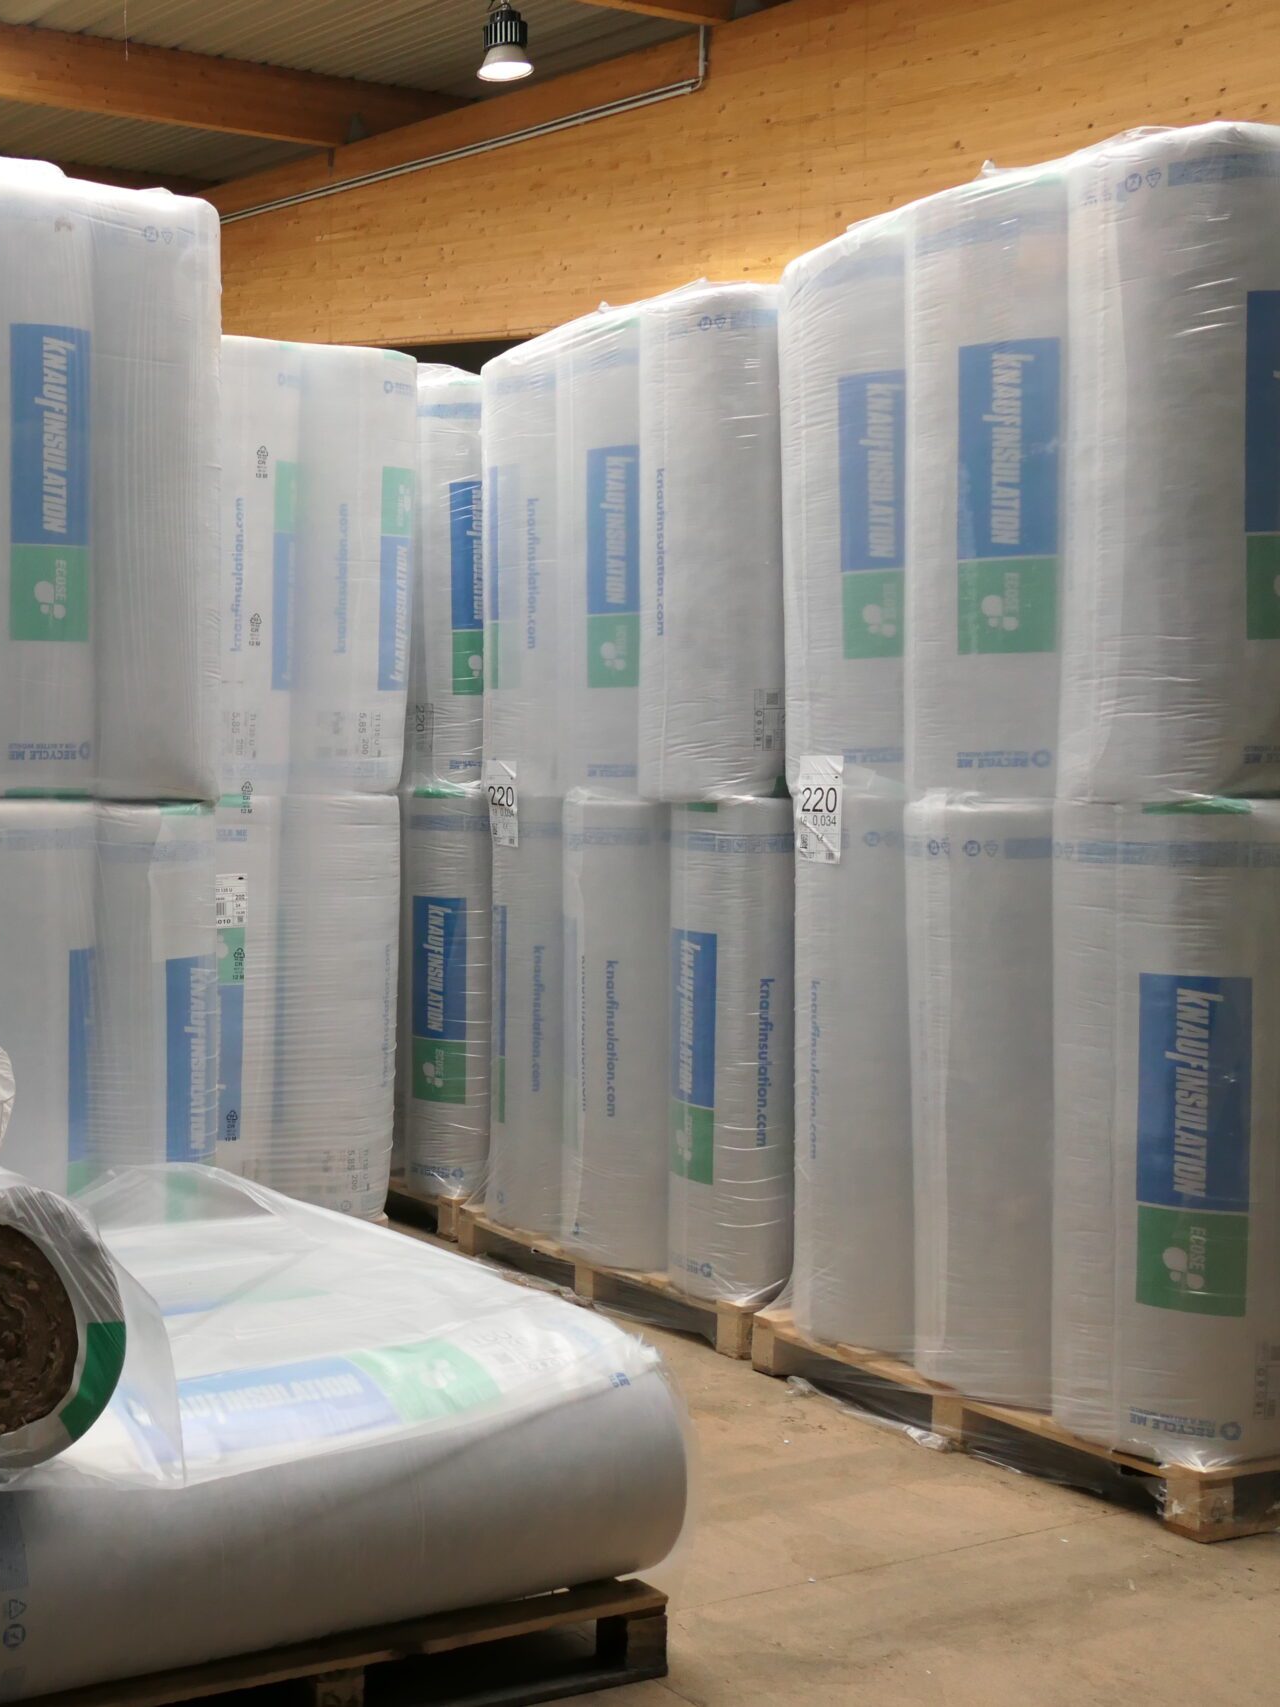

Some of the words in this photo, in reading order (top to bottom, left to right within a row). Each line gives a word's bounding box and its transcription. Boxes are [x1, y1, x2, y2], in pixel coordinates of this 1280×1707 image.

[230, 497, 244, 652] knaufinsulation.com
[488, 786, 514, 807] 220
[802, 787, 837, 813] 220
[423, 905, 452, 1032] KNAUFINSULATION
[531, 945, 545, 1093] knaufinsulation.com
[605, 960, 620, 1117] knaufinsulation.com
[756, 978, 774, 1147] knaufinsulation.com
[1165, 988, 1224, 1198] KNAUFINSULATION
[1190, 1226, 1207, 1270] ECOSE
